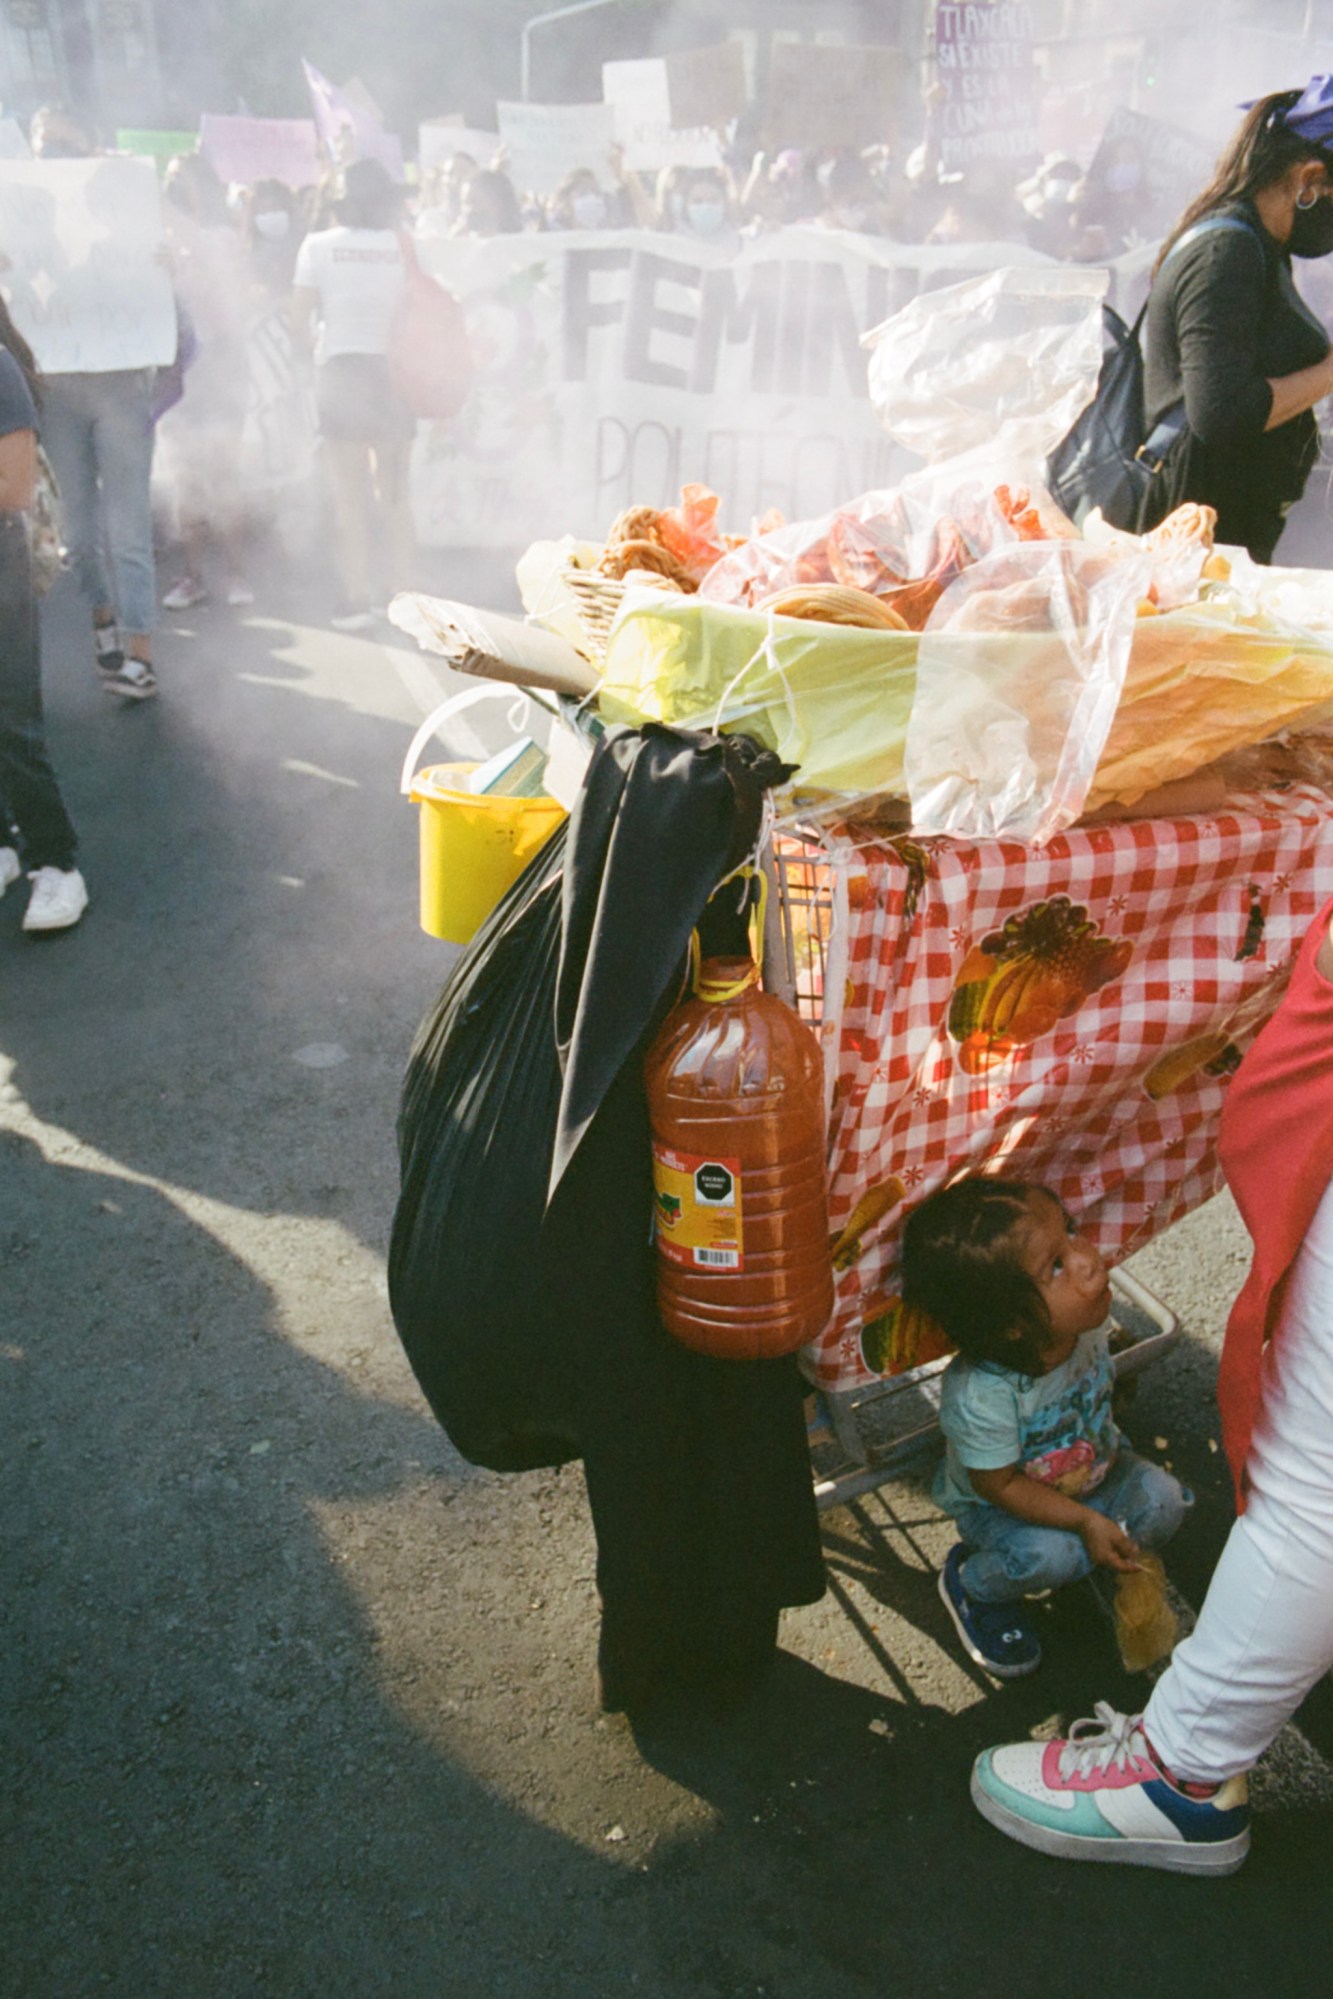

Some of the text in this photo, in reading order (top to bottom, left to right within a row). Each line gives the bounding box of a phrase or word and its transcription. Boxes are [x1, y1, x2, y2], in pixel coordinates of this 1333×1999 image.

[939, 4, 1034, 40] TLAXCALA
[958, 41, 1023, 69] EXISTE
[961, 76, 982, 99] ES
[988, 73, 1011, 97] LA
